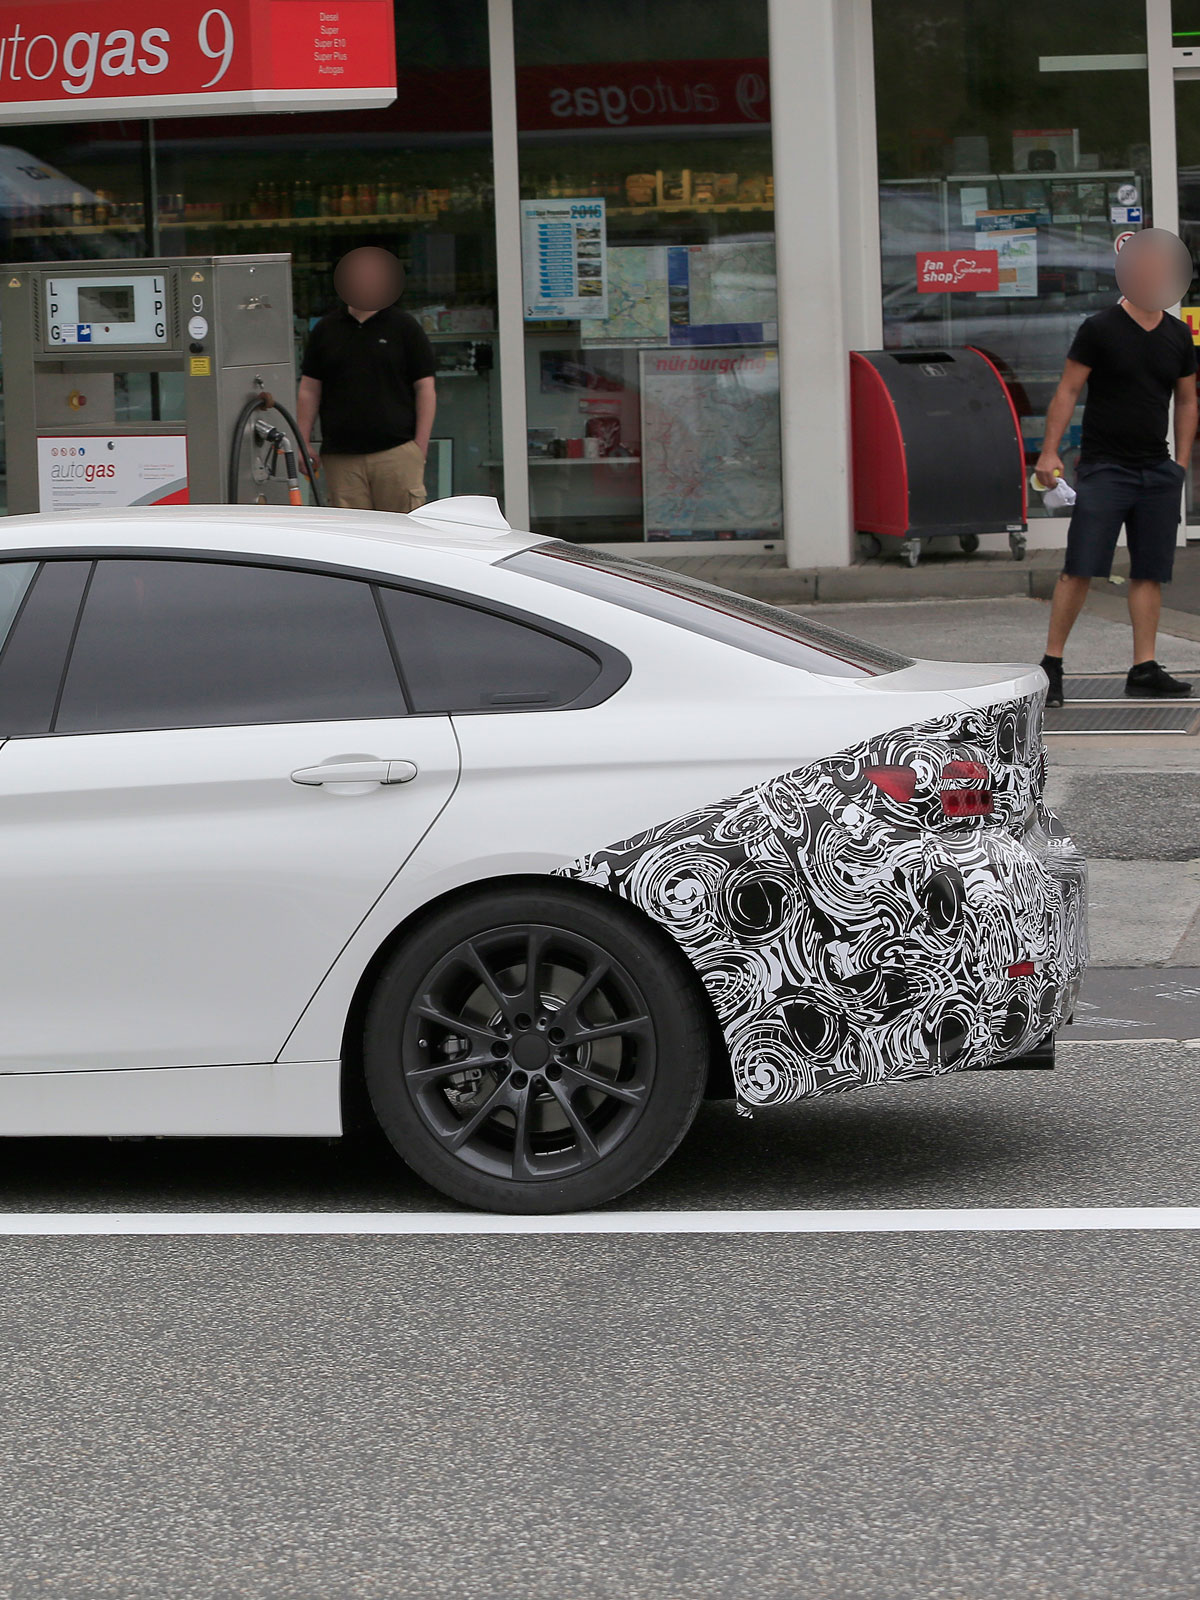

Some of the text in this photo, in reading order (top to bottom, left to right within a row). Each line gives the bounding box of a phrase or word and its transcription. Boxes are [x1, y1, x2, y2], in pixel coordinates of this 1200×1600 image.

[319, 12, 339, 21] Diesel
[320, 25, 339, 36] Super
[198, 9, 234, 88] 9
[314, 38, 332, 49] Super
[314, 51, 347, 62] Super Plus
[318, 65, 344, 75] Autogas
[923, 259, 944, 273] fan
[923, 271, 953, 284] shop
[191, 294, 203, 313] 9
[656, 354, 766, 375] nürburgring
[51, 461, 116, 482] autogas
